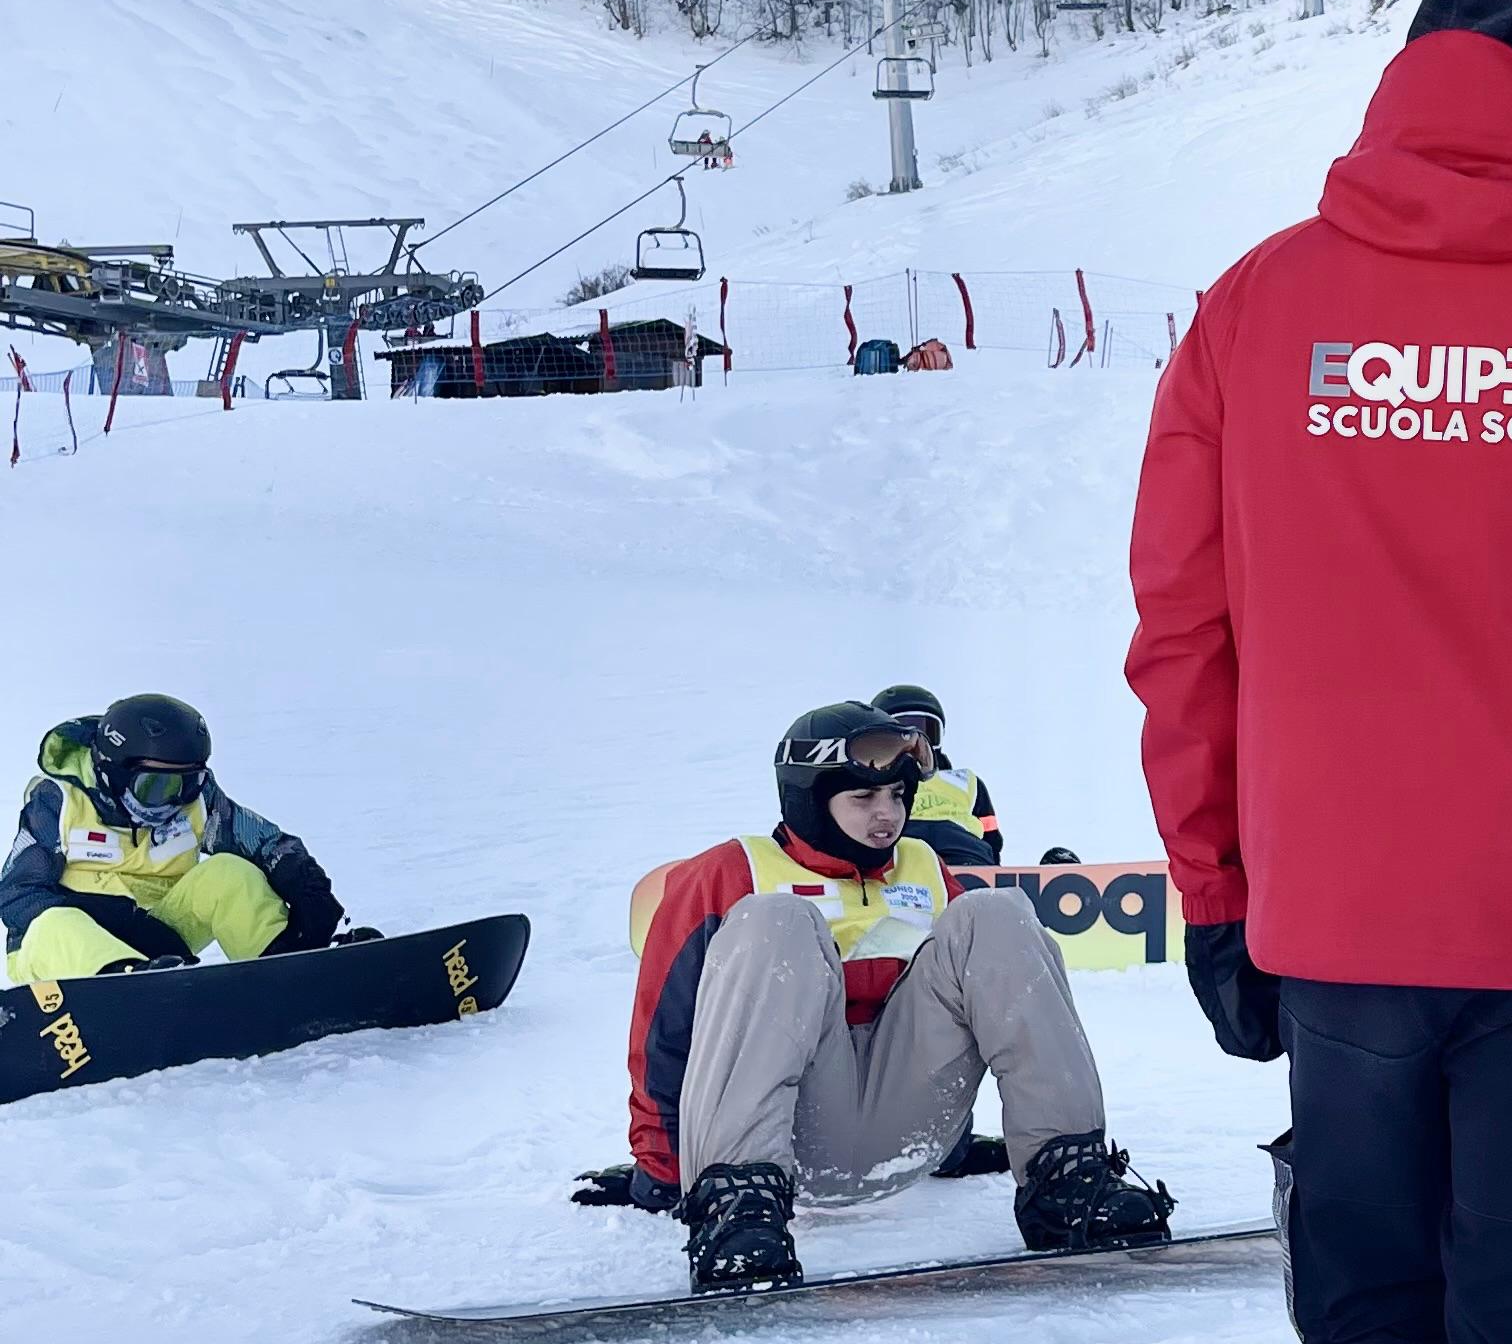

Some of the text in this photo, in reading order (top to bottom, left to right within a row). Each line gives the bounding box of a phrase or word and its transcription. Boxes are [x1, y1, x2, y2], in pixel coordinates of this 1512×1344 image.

[1306, 403, 1469, 442] SCUOLA
[442, 938, 479, 997] head
[43, 993, 60, 1011] 35
[39, 1012, 92, 1080] head
